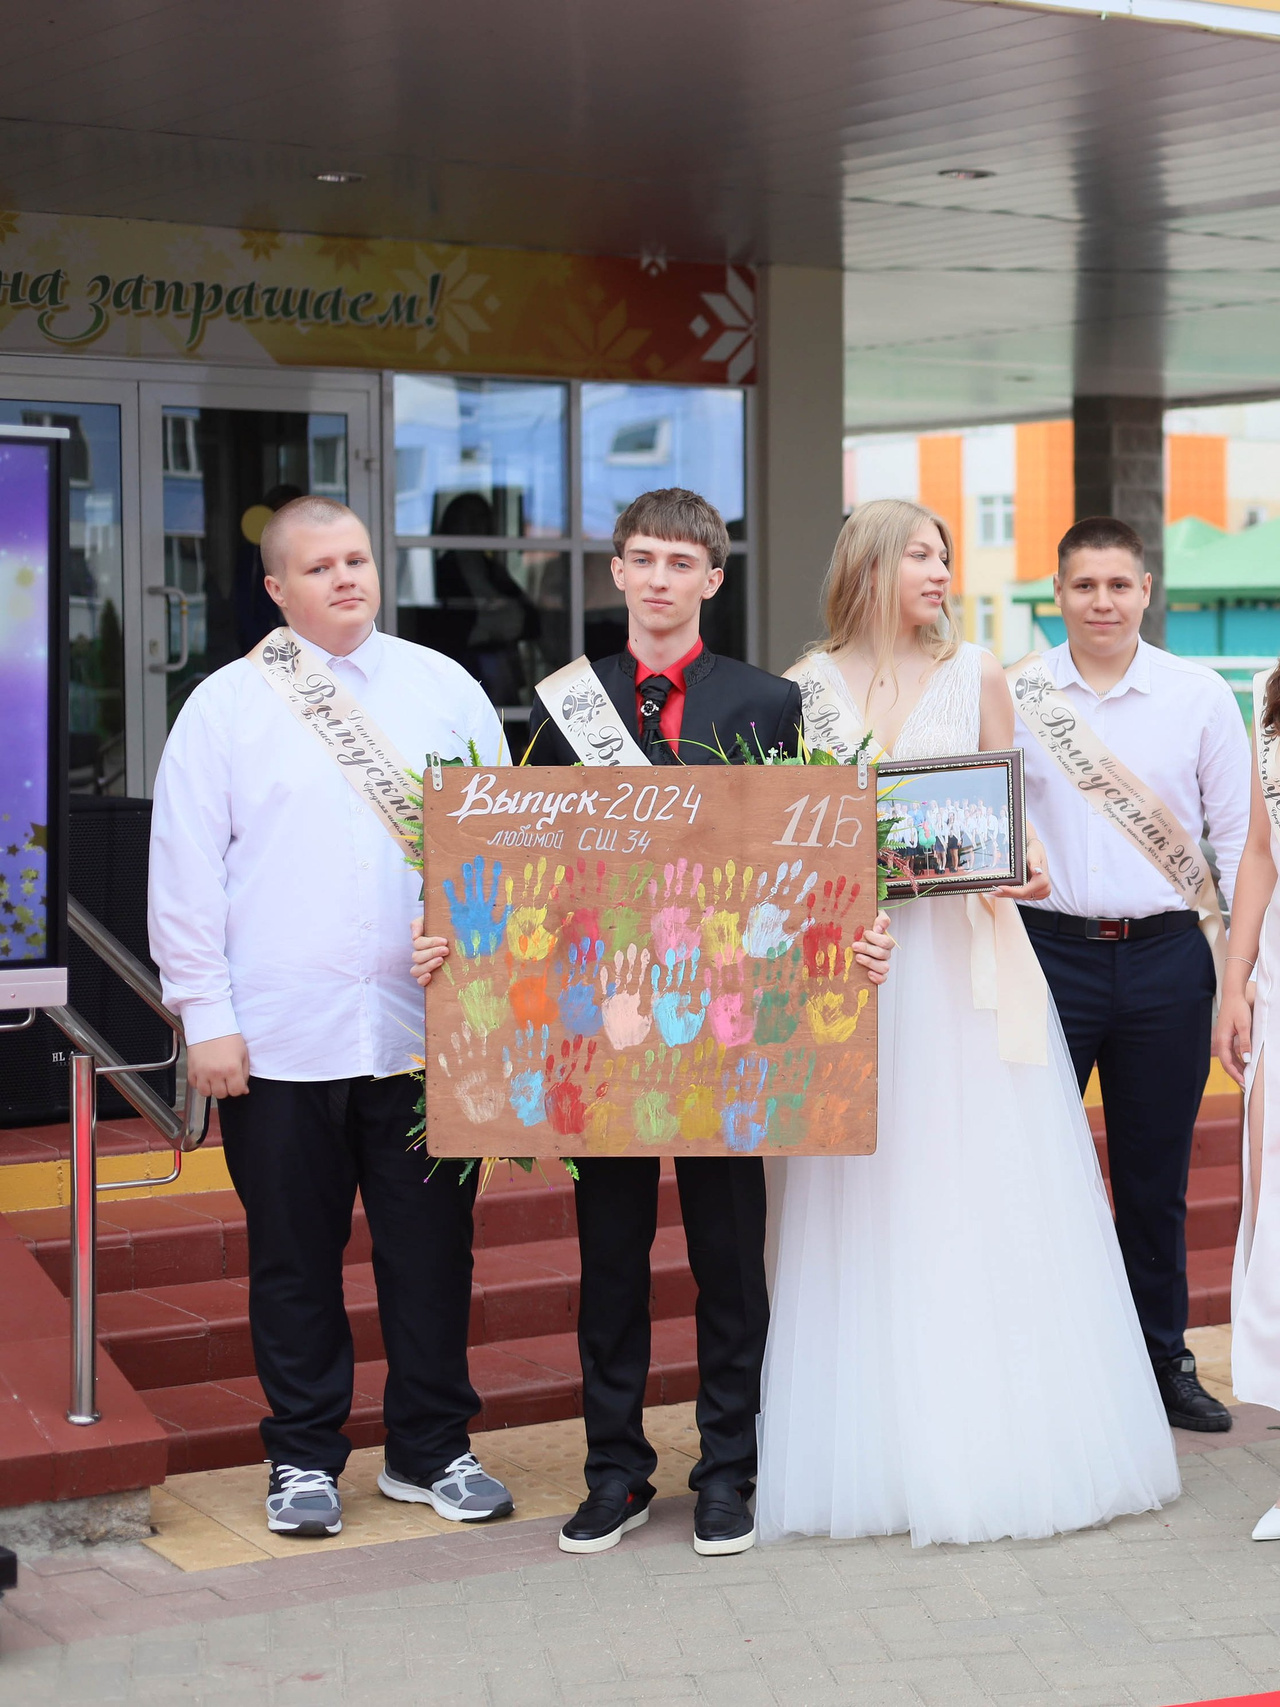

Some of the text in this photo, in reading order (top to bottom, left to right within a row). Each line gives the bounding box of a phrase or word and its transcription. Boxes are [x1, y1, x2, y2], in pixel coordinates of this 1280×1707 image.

[37, 272, 445, 347] запрашаем!
[312, 723, 335, 748] класс
[363, 780, 389, 815] Средняя
[446, 772, 702, 831] Выпуск-2024
[771, 793, 867, 849] 11Б
[1040, 706, 1205, 895] Выпускник 2024
[487, 827, 652, 854] любимой СШ 34
